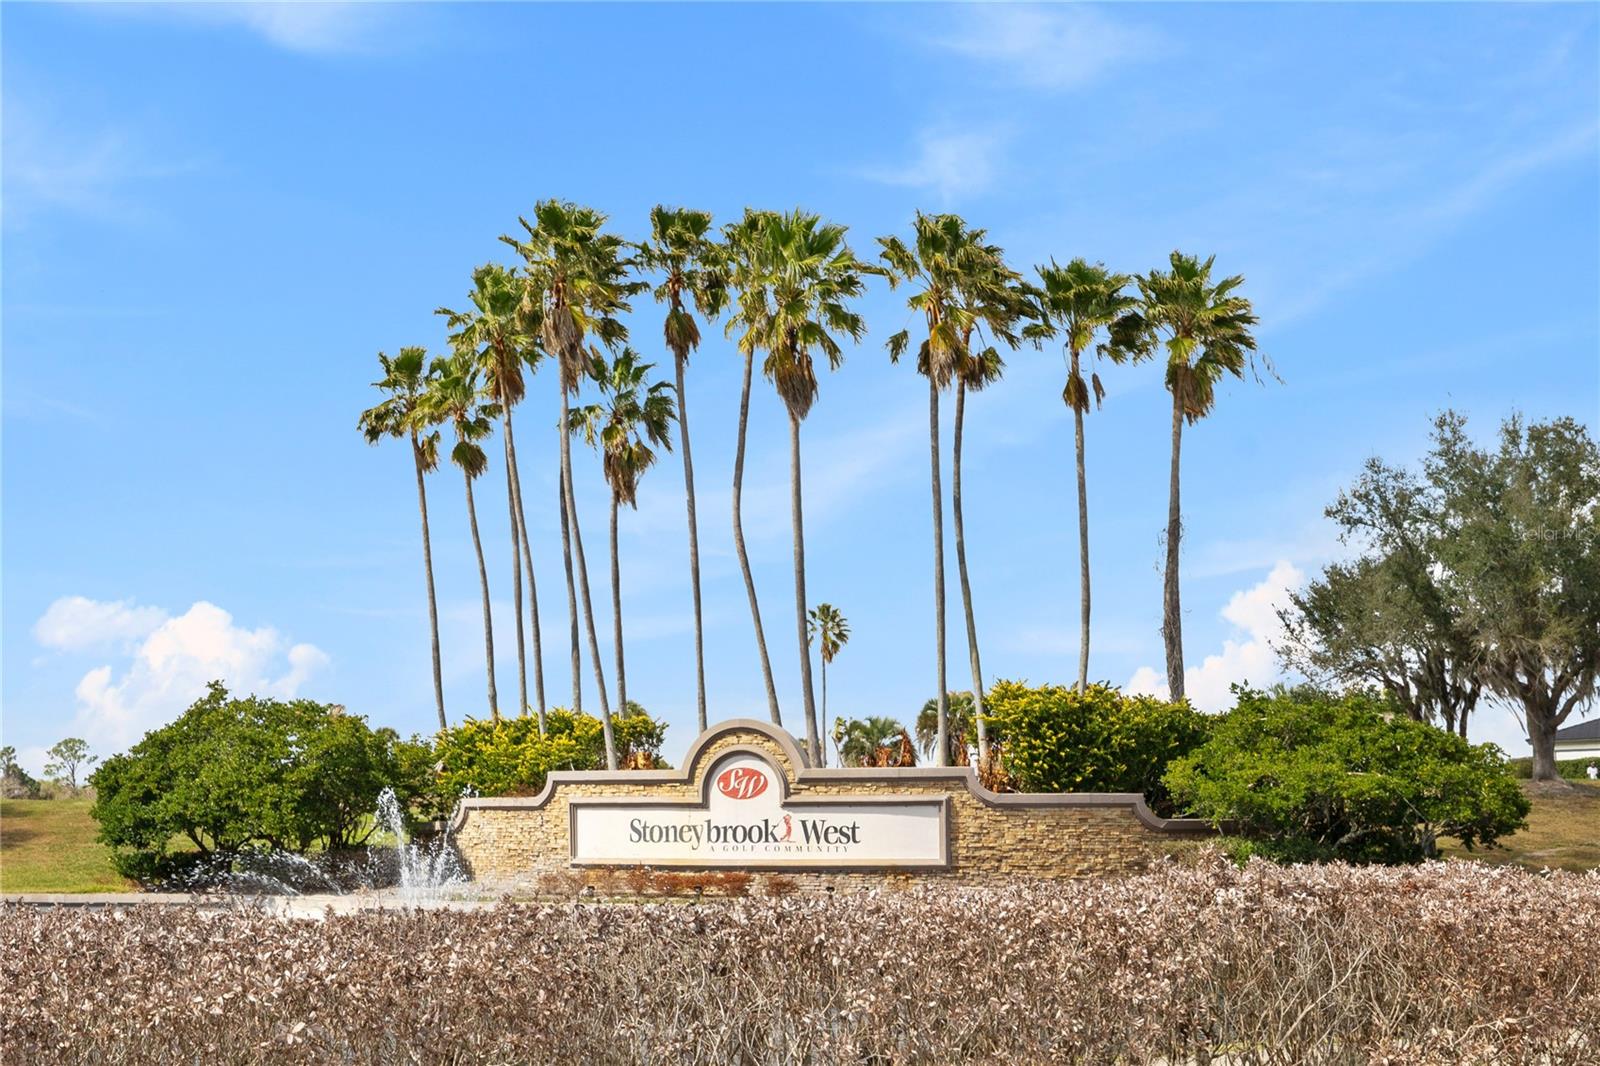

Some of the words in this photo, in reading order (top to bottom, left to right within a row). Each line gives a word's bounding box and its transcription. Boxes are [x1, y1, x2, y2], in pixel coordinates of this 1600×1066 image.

[719, 768, 765, 799] SW
[629, 817, 781, 851] Stoneybrook
[798, 818, 861, 845] West
[710, 845, 716, 853] A
[722, 845, 755, 853] GOLF
[764, 845, 850, 853] COMMUNITY
